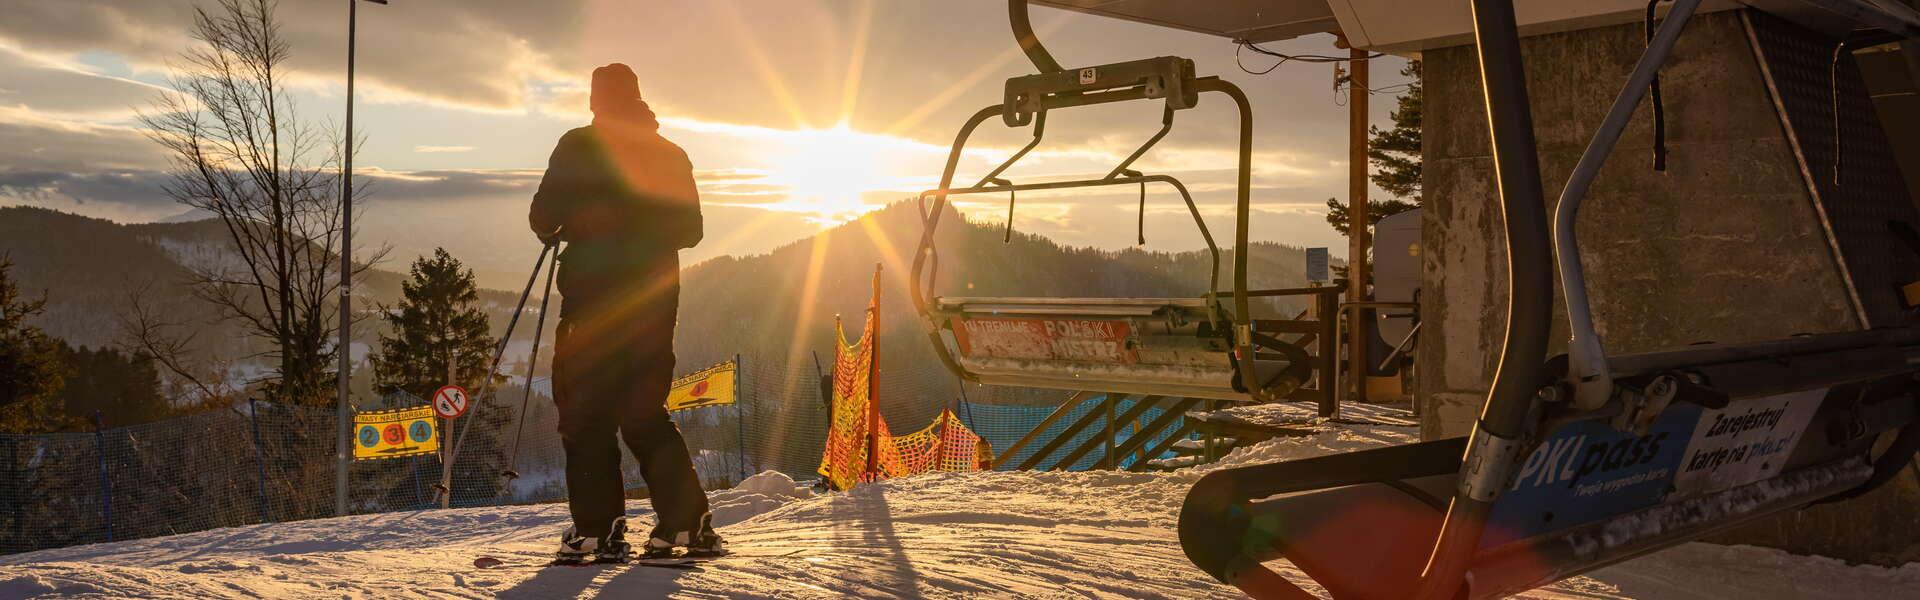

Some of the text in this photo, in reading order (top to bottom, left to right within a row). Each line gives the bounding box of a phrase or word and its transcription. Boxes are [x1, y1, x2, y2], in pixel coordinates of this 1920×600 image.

[1082, 70, 1093, 79] 43
[1044, 319, 1116, 338] POLSKI
[1705, 401, 1789, 438] Zarejestruj
[363, 424, 426, 444] 2 3 4
[1685, 446, 1729, 473] kartę
[1727, 445, 1748, 464] na
